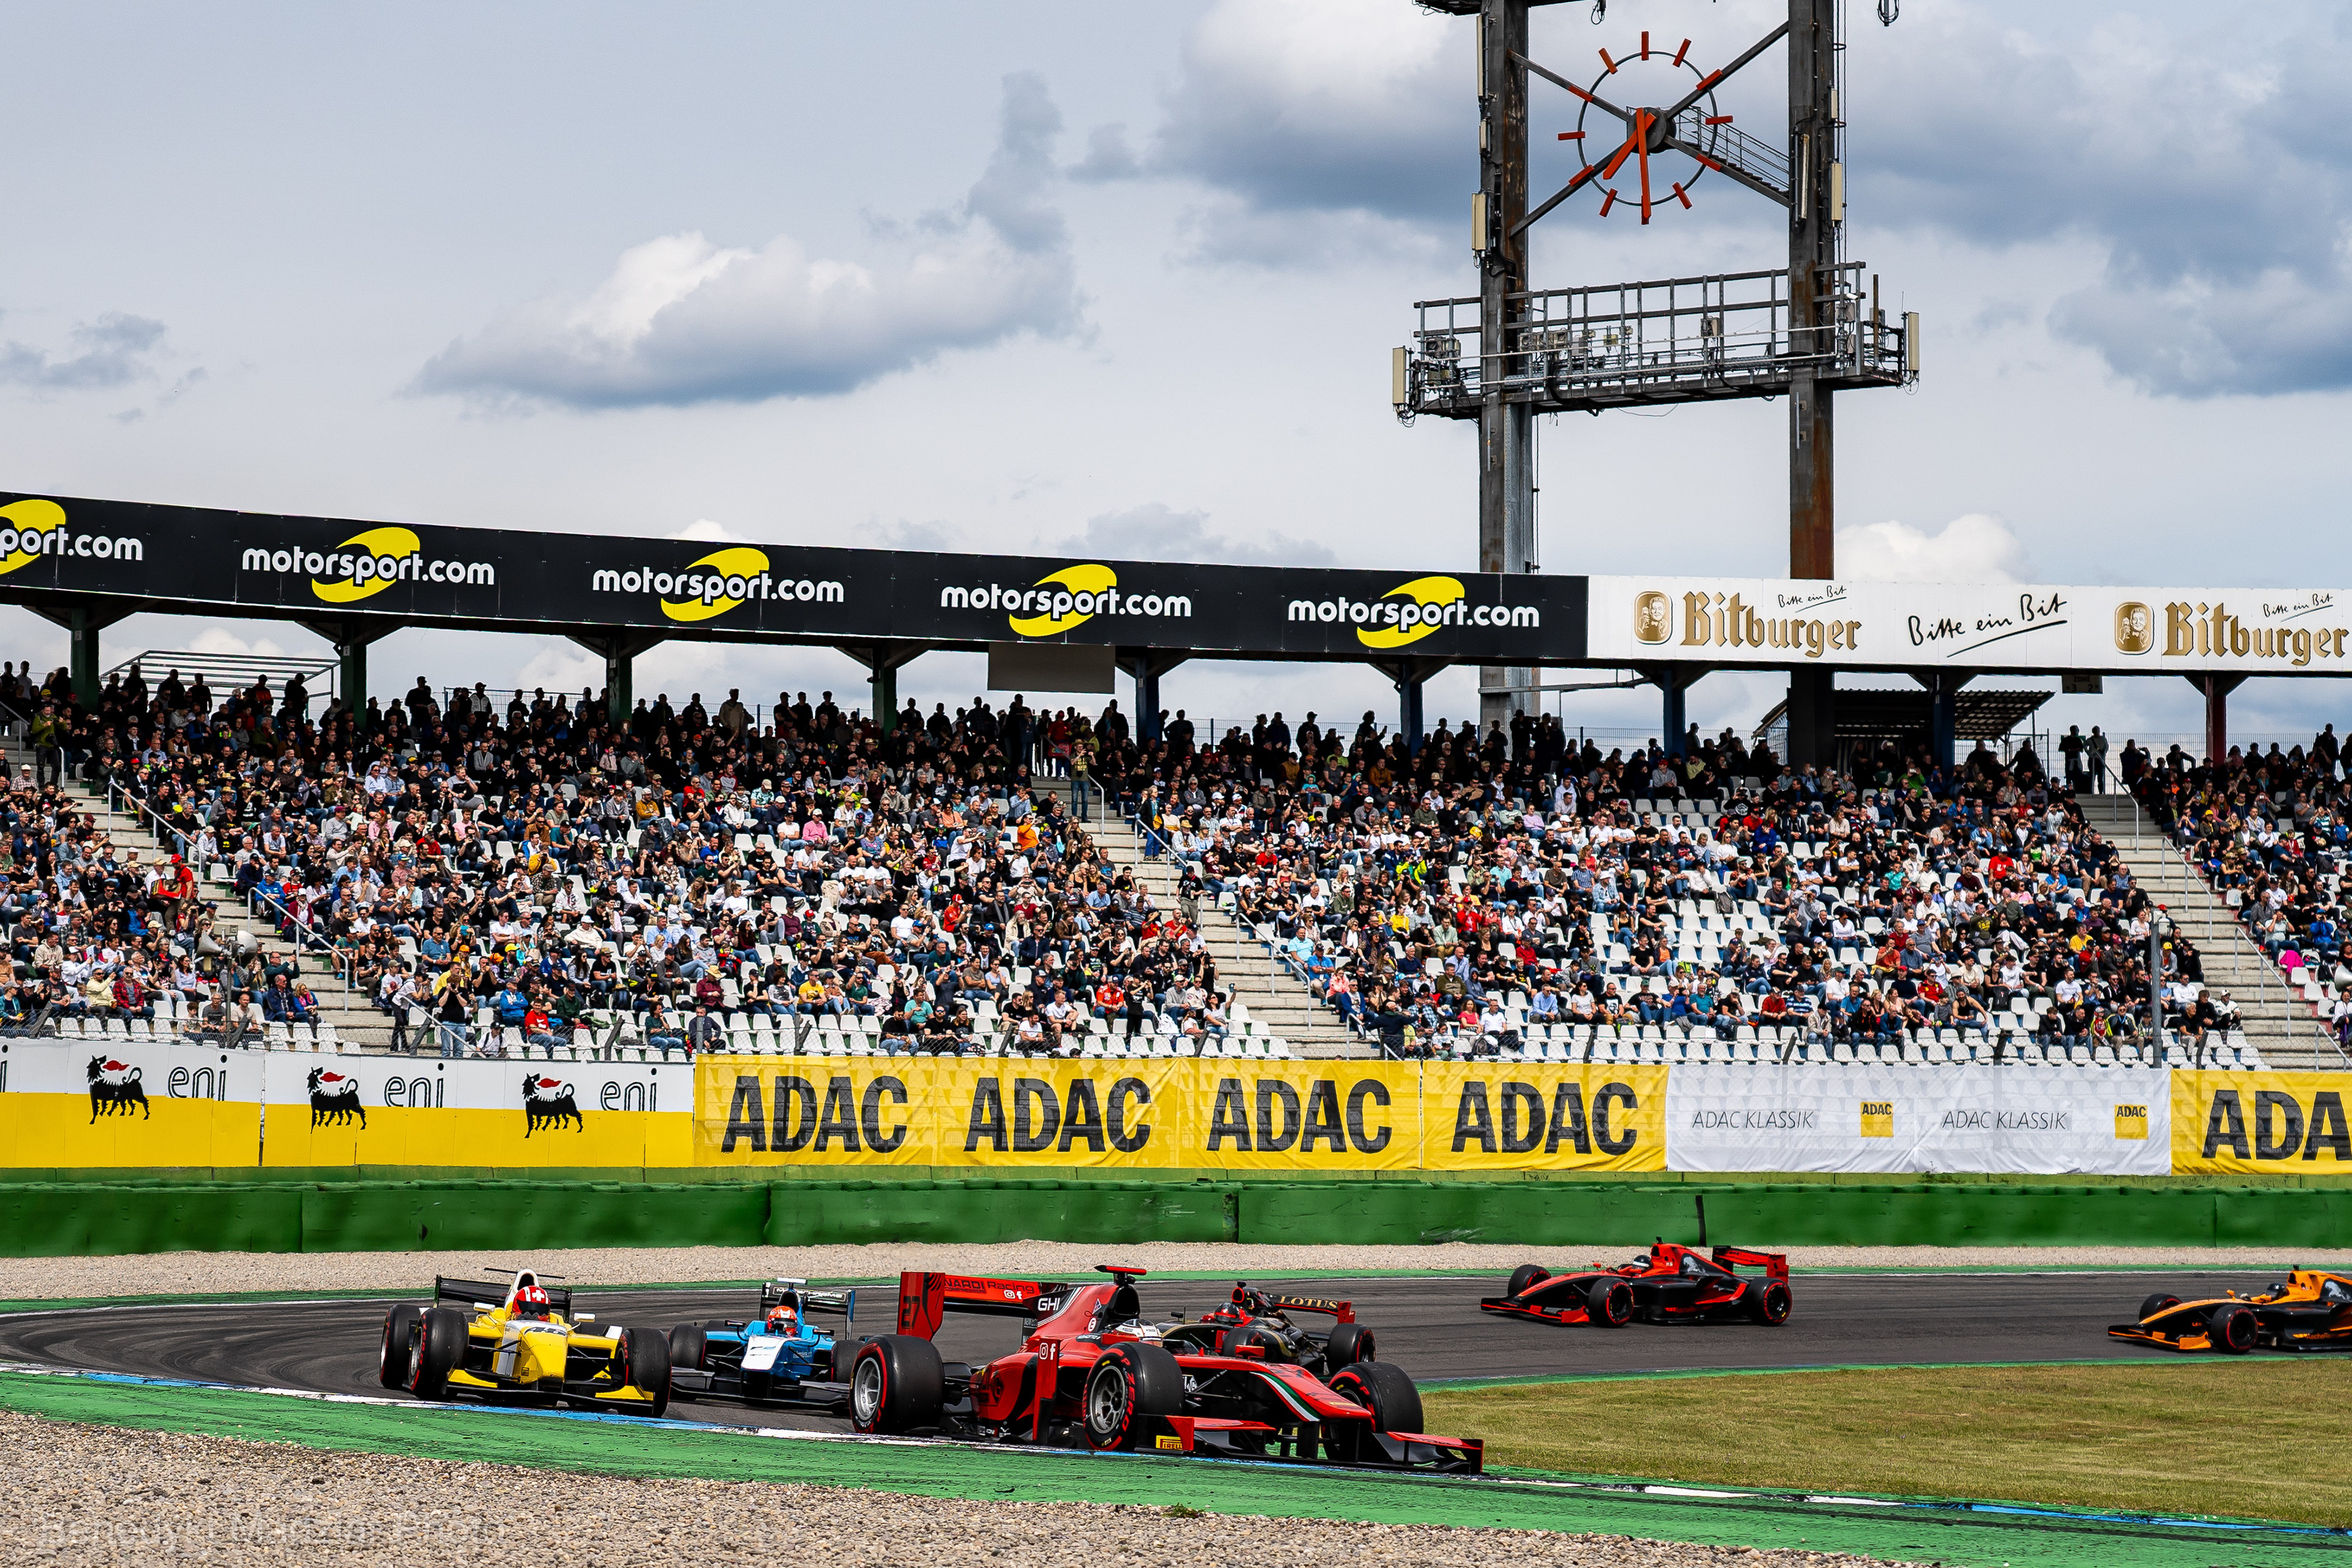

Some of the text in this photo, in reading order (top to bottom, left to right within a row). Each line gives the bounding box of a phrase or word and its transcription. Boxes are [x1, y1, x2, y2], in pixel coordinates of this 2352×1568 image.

[242, 546, 494, 585] motorsport.com
[592, 567, 844, 603] motorsport.com
[941, 583, 1191, 619] motorsport.com
[1778, 594, 1804, 608] Bitte
[1826, 584, 1847, 597] Bit
[1288, 597, 1539, 631] motorsport.com
[1908, 592, 2067, 647] Bitte ein Bit
[2263, 593, 2333, 617] Bitte ein Bit
[1679, 591, 1863, 658] Bitburger
[2161, 601, 2350, 666] Bitburger
[167, 1054, 228, 1102] eni
[383, 1062, 444, 1109] eni
[600, 1068, 657, 1112] eni
[721, 1075, 908, 1153] ADAC
[963, 1077, 1151, 1153] ADAC
[1206, 1078, 1392, 1154] ADAC
[1450, 1081, 1638, 1156] ADAC
[1692, 1111, 1814, 1129] ADAC KLASSIK
[1862, 1103, 1892, 1115] ADAC
[1942, 1111, 2067, 1130] ADAC KLASSIK
[2116, 1106, 2146, 1118] ADAC
[987, 1281, 1035, 1294] Racing
[1038, 1297, 1061, 1311] GHI
[1279, 1295, 1338, 1310] LOTUS
[901, 1295, 920, 1330] 27
[1121, 1372, 1136, 1432] ZERO
[1160, 1439, 1183, 1450] PIRELL
